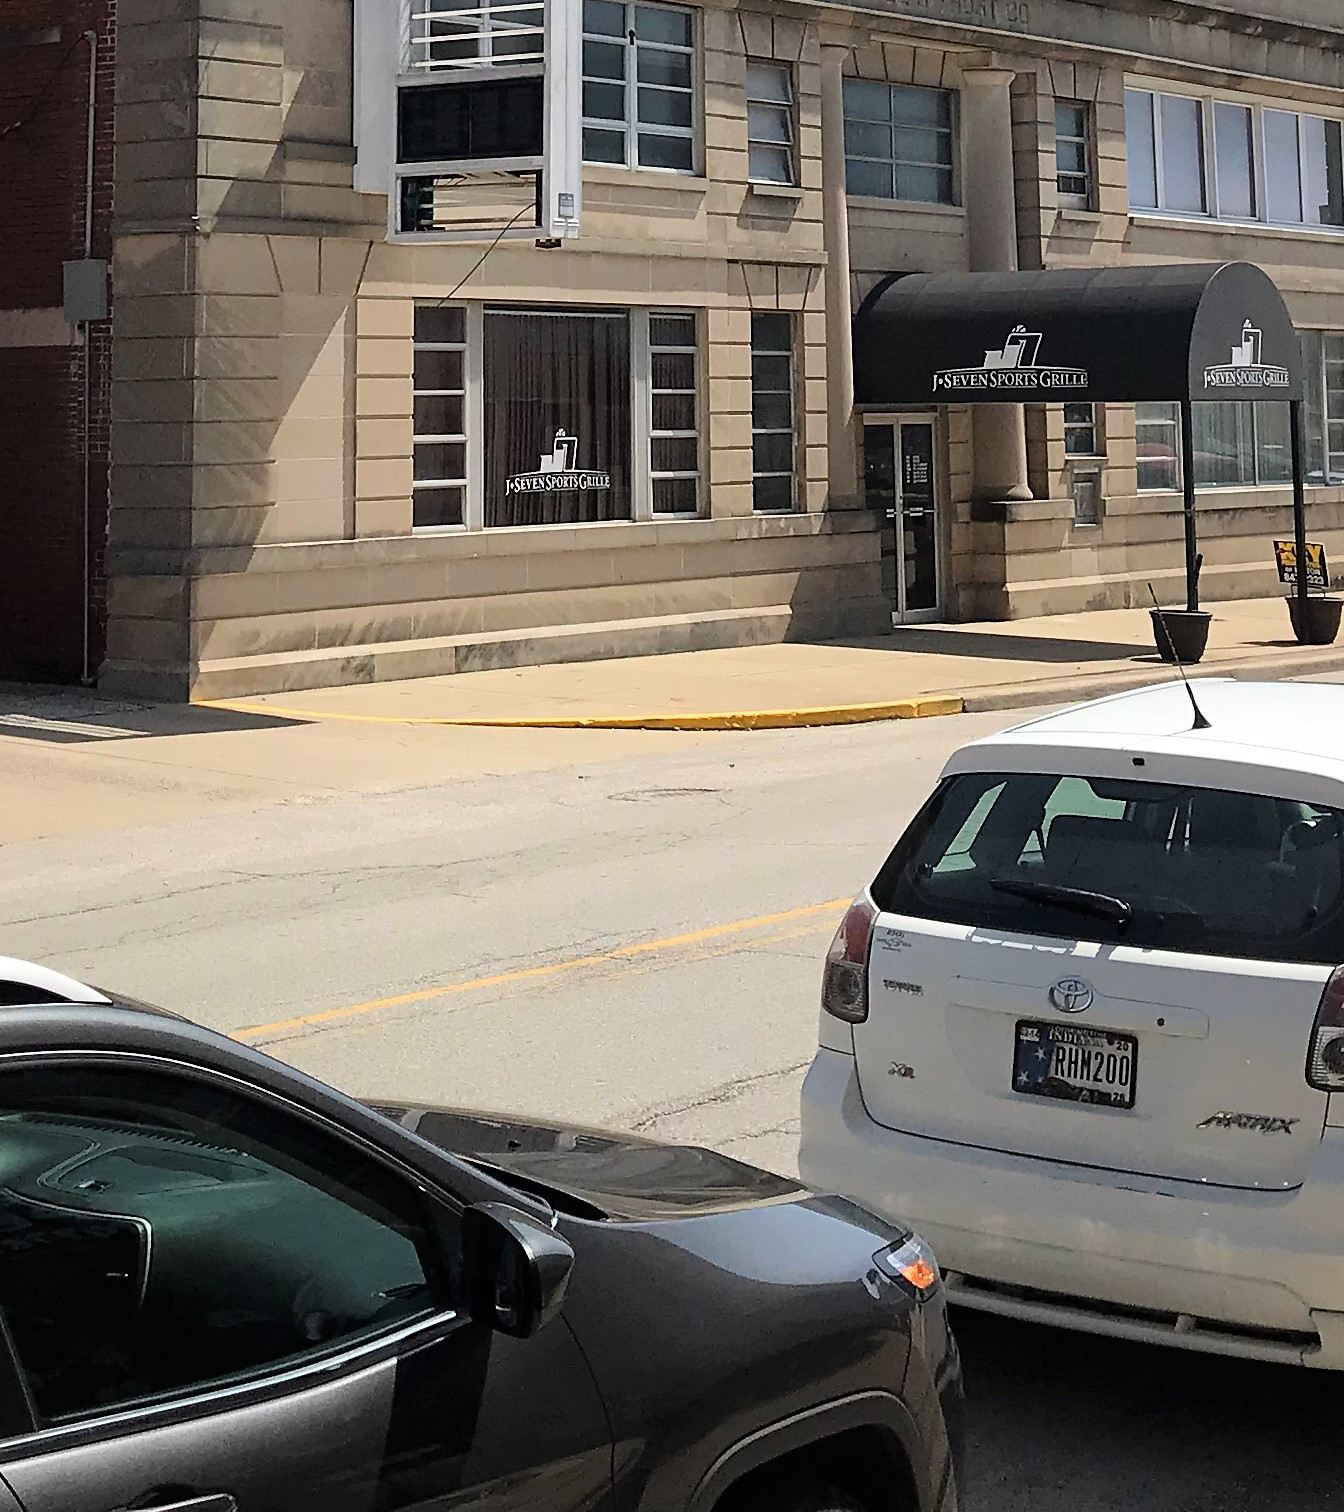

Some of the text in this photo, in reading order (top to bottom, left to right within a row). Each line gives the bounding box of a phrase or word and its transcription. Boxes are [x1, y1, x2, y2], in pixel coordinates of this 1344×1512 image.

[989, 370, 1038, 388] SPORTS
[1040, 370, 1089, 387] GRILLE
[546, 474, 578, 491] SPORTS
[579, 473, 611, 490] GRILLE
[1196, 1110, 1301, 1135] MATRIX
